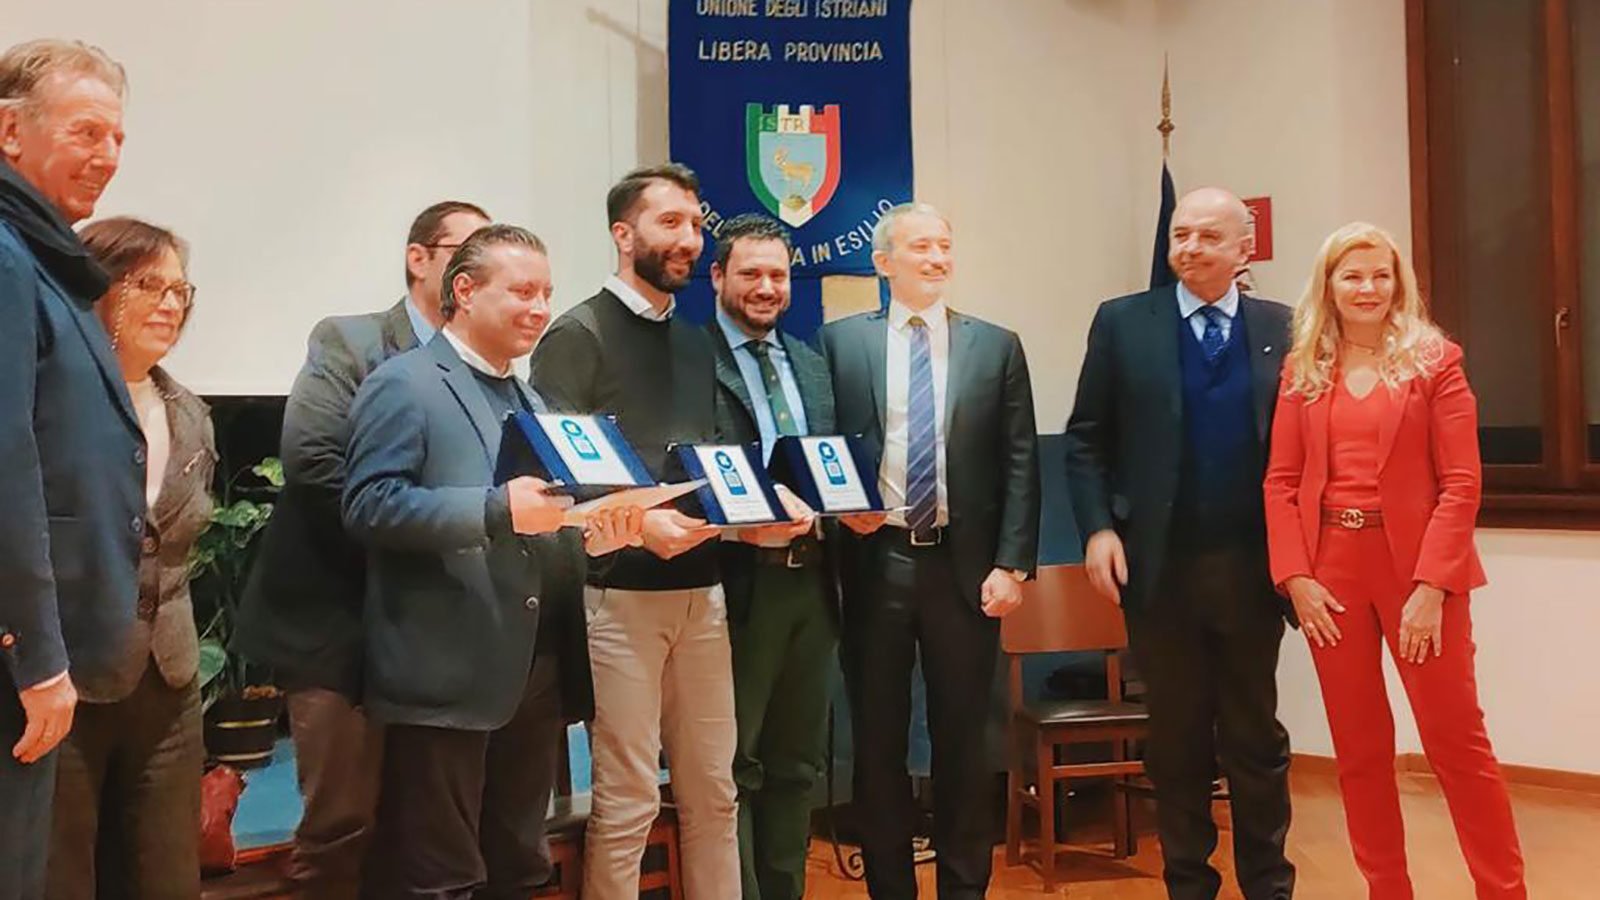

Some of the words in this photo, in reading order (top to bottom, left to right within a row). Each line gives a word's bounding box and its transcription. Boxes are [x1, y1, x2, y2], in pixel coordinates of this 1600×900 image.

[696, 0, 758, 17] UNIONE
[765, 0, 808, 17] DEGLI
[815, 0, 887, 18] ISTRIANI
[698, 40, 772, 61] LIBERA
[784, 41, 884, 62] PROVINCIA
[811, 242, 832, 264] IN
